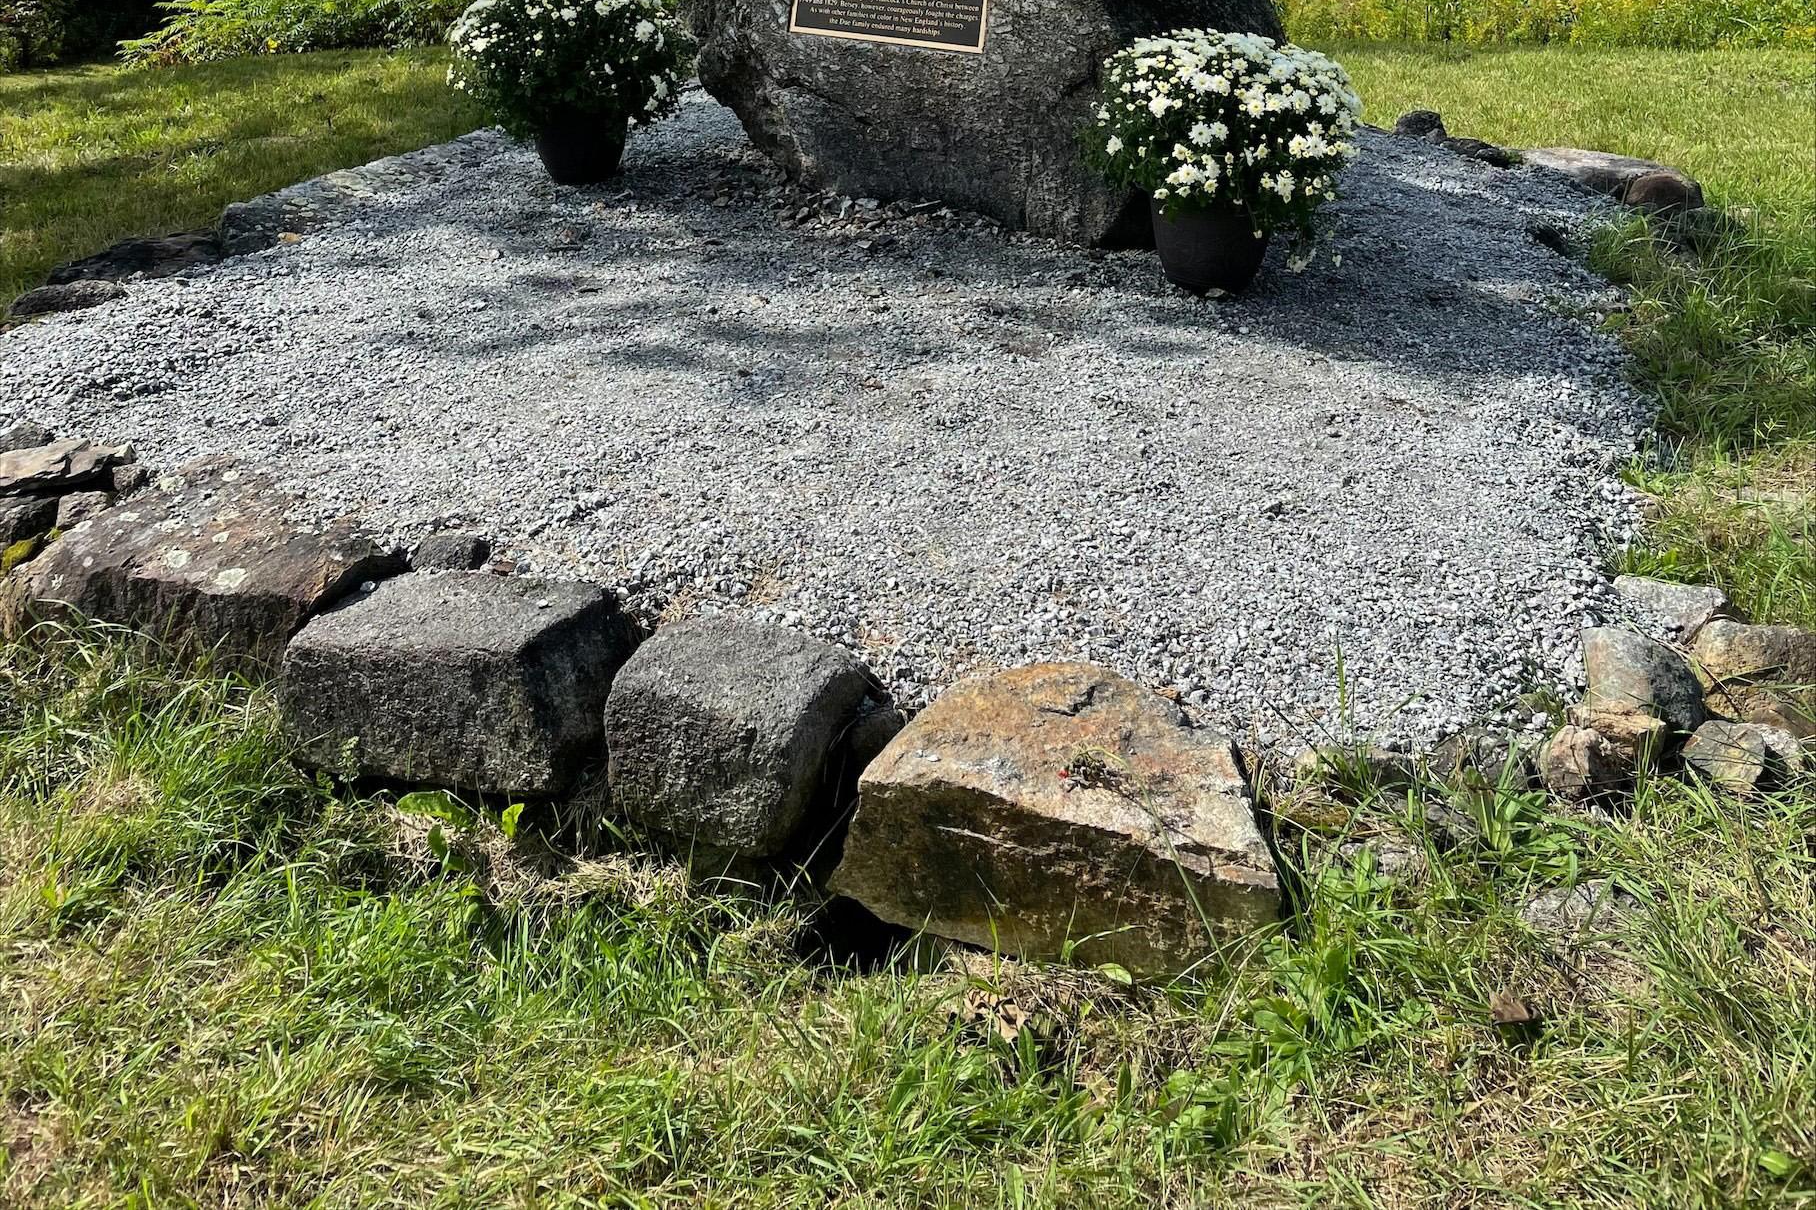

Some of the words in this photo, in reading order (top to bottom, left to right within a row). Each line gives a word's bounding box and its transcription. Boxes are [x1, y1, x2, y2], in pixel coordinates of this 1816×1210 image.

[887, 5, 923, 16] courageously
[925, 9, 944, 18] fought
[852, 20, 870, 29] family
[871, 22, 894, 30] endured
